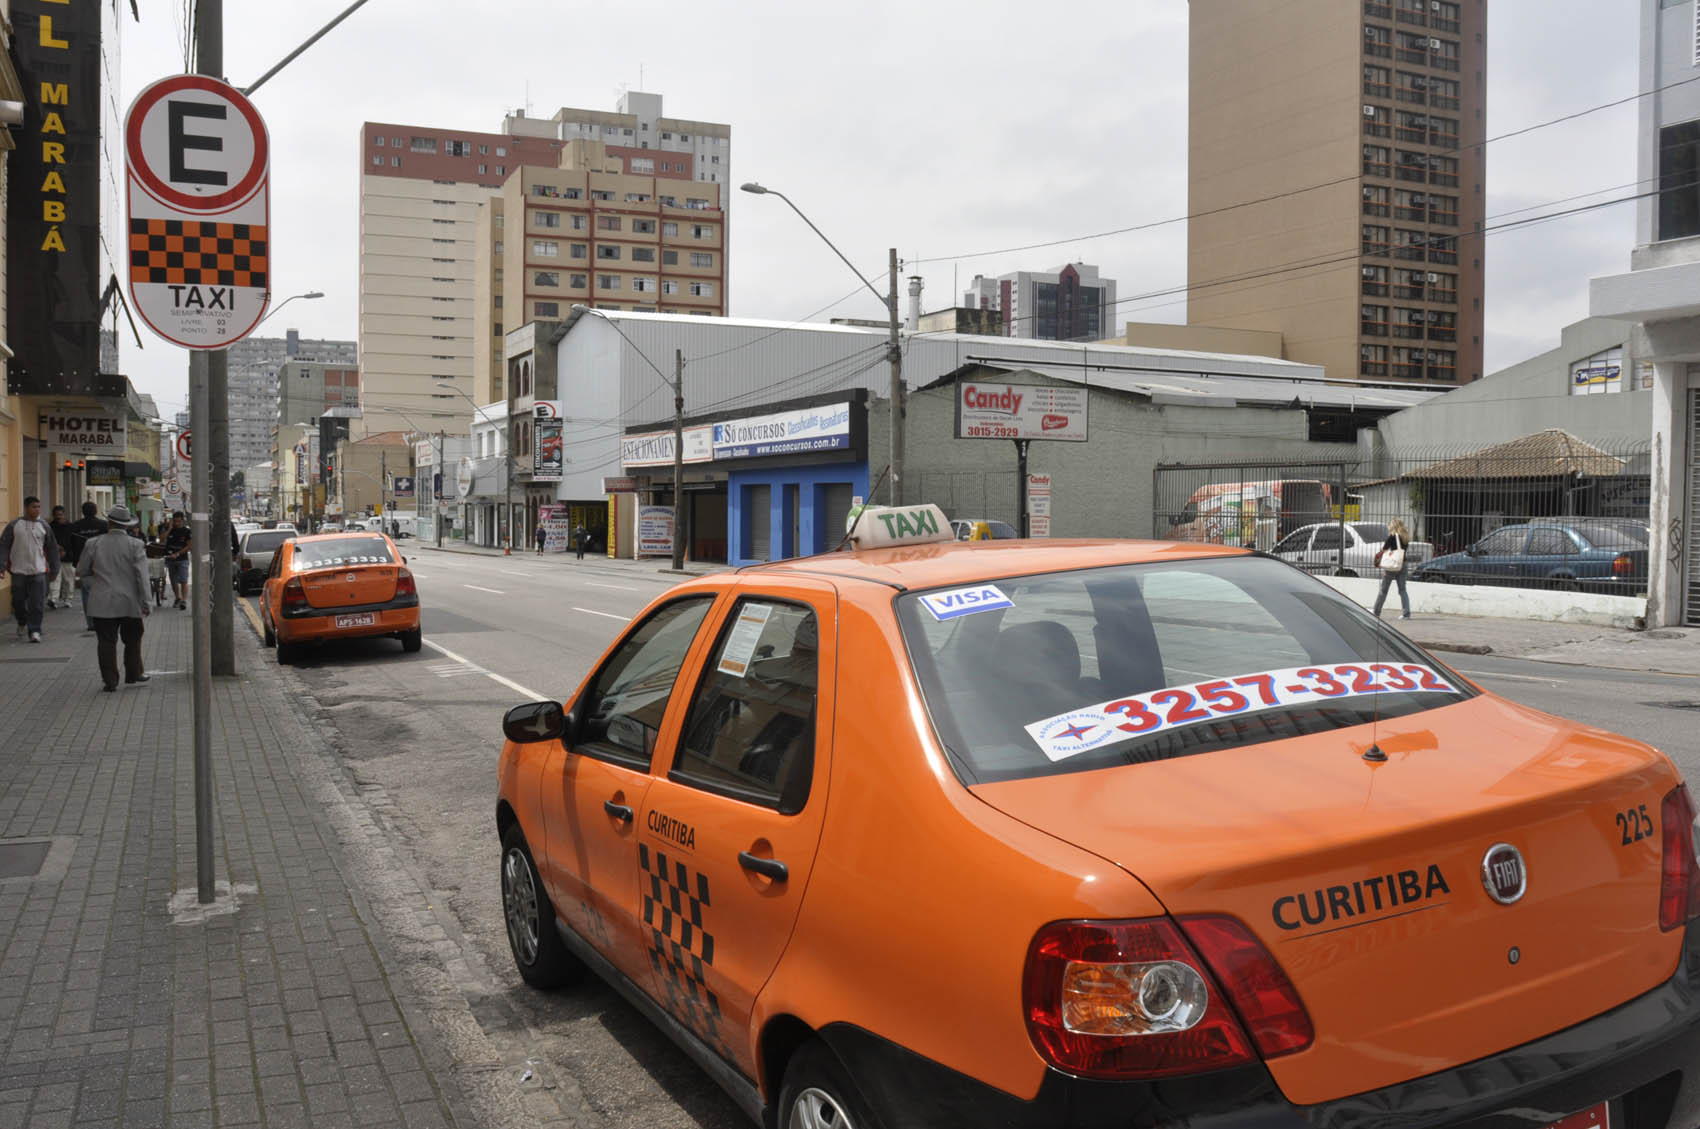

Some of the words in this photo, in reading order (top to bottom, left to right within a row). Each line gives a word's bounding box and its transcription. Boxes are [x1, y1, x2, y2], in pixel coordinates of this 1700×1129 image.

[168, 100, 228, 186] E
[41, 82, 69, 252] MARABÁ
[168, 285, 234, 311] TAXI
[964, 385, 1022, 415] Candy
[49, 416, 124, 432] HOTEL
[738, 422, 785, 442] CONCURSOS
[967, 426, 1019, 437] 3015-2929
[757, 437, 840, 454] www.soconcursos.com.br
[877, 509, 939, 539] TAXI
[933, 589, 1000, 607] VISA
[1104, 664, 1451, 733] 3257-3232
[648, 809, 696, 850] CURITIBA
[1615, 804, 1654, 847] 225
[1493, 858, 1519, 890] FIAT
[1271, 863, 1451, 931] CURITIBA
